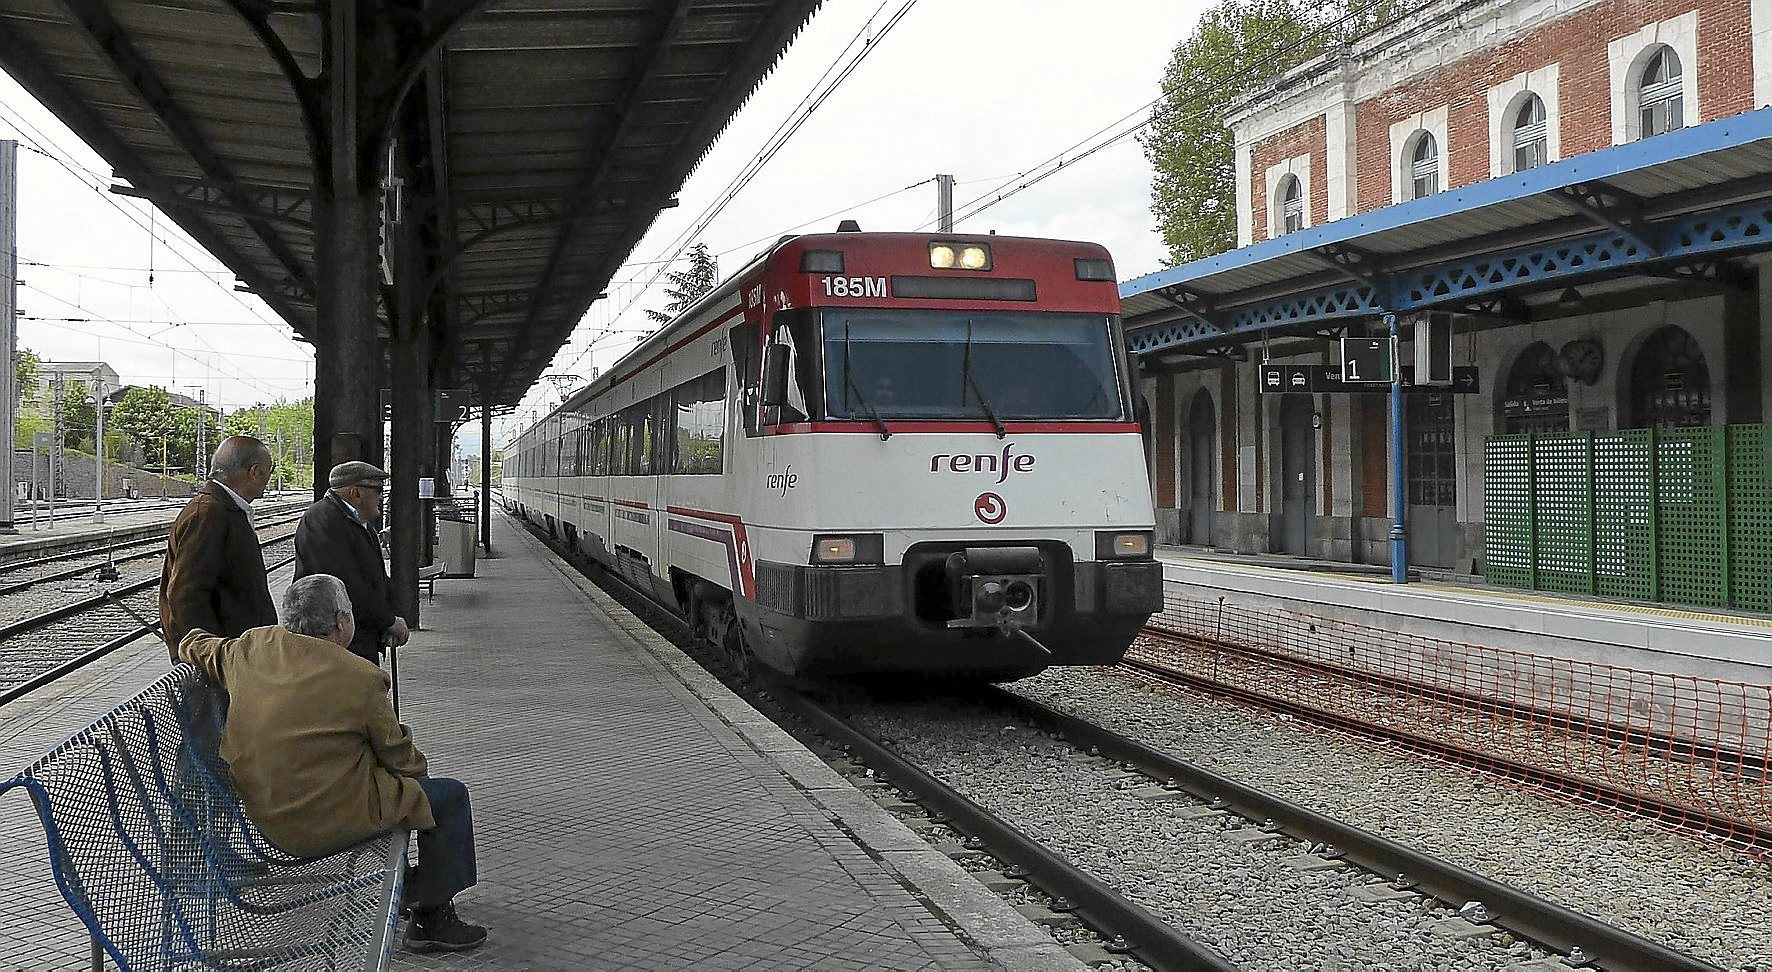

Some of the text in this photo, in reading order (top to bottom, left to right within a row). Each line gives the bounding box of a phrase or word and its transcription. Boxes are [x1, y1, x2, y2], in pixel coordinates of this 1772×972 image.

[821, 275, 888, 299] 185M
[1325, 371, 1343, 381] Ven
[1348, 359, 1361, 380] 1
[458, 405, 468, 421] 2
[929, 442, 1036, 485] renfe
[766, 464, 798, 498] renfe
